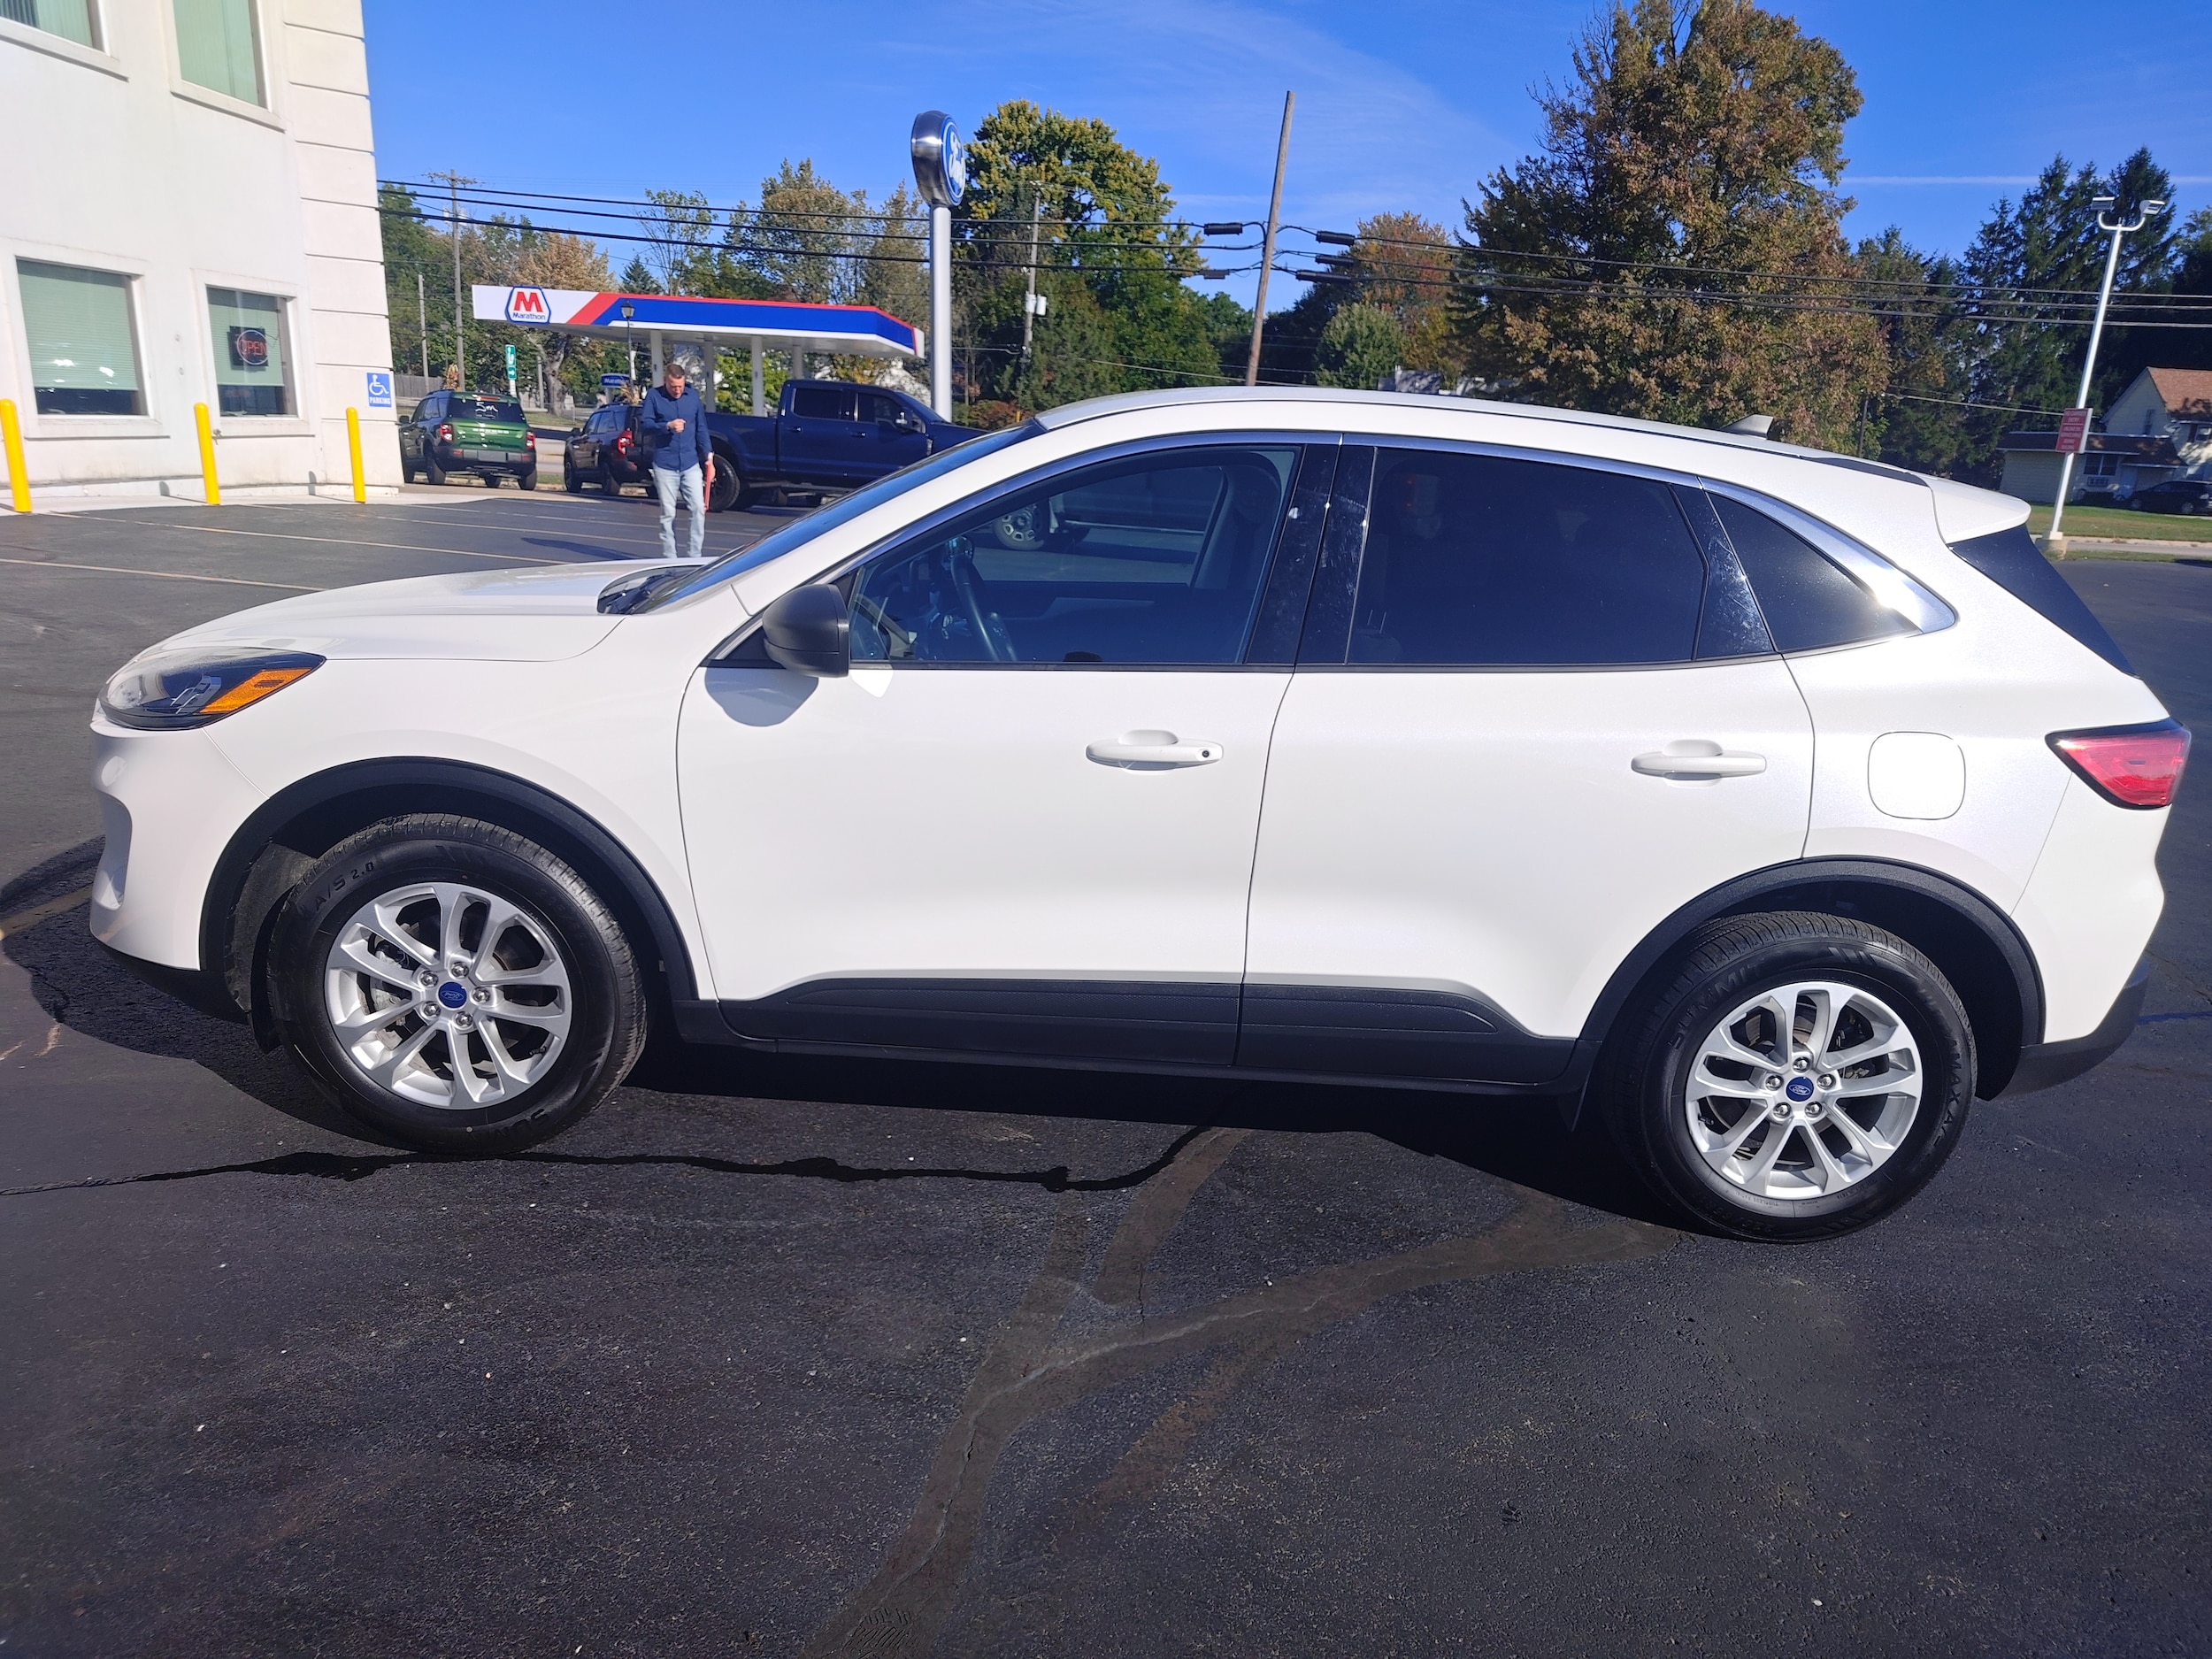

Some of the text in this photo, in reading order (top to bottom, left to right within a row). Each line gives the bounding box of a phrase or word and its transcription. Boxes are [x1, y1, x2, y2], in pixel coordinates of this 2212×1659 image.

[514, 291, 543, 312] M
[239, 339, 267, 357] OPEN
[369, 396, 391, 405] PARKING
[315, 861, 375, 911] A/S 2.0
